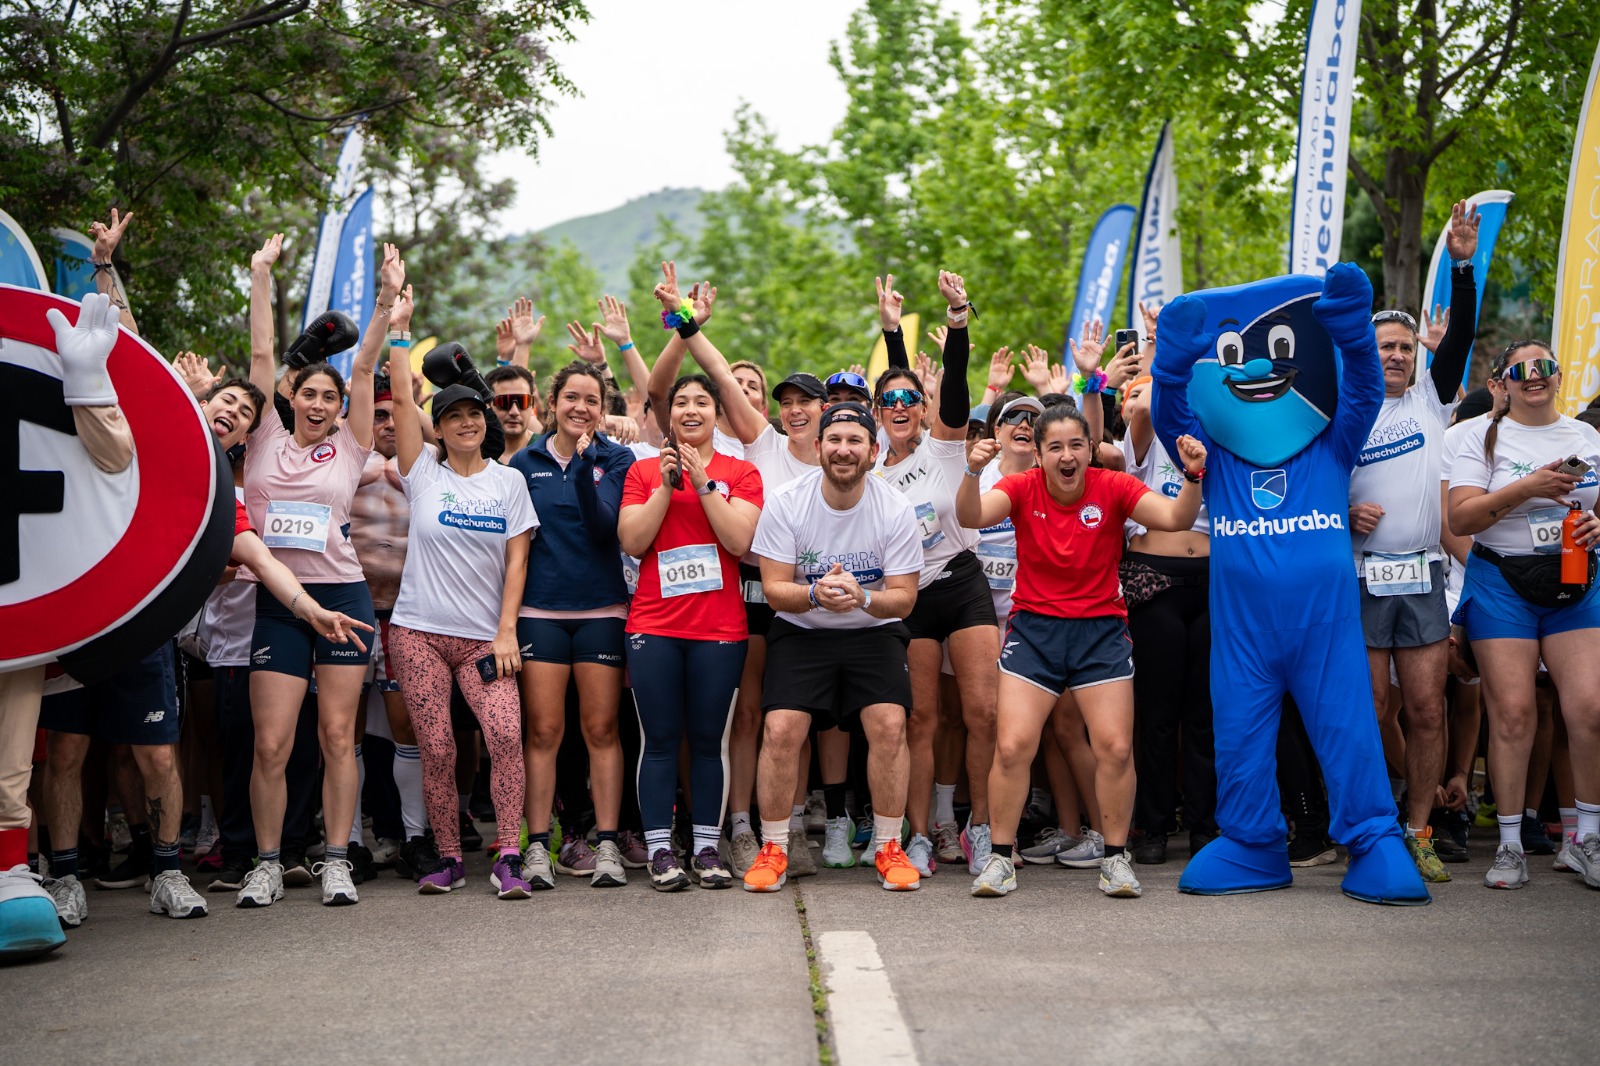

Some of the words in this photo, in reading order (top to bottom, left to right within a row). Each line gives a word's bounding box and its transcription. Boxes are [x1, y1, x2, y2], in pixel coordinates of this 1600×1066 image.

[1314, 68, 1324, 102] DE
[1388, 422, 1422, 442] CHILE
[531, 471, 553, 479] SPARTA
[442, 500, 470, 514] TEAM
[474, 505, 508, 518] CHILE
[271, 518, 314, 535] 0219
[1536, 526, 1562, 542] 09
[820, 551, 879, 565] CORRIDA
[844, 560, 880, 572] CHILE
[666, 562, 706, 582] 0181
[1369, 563, 1418, 582] 1871
